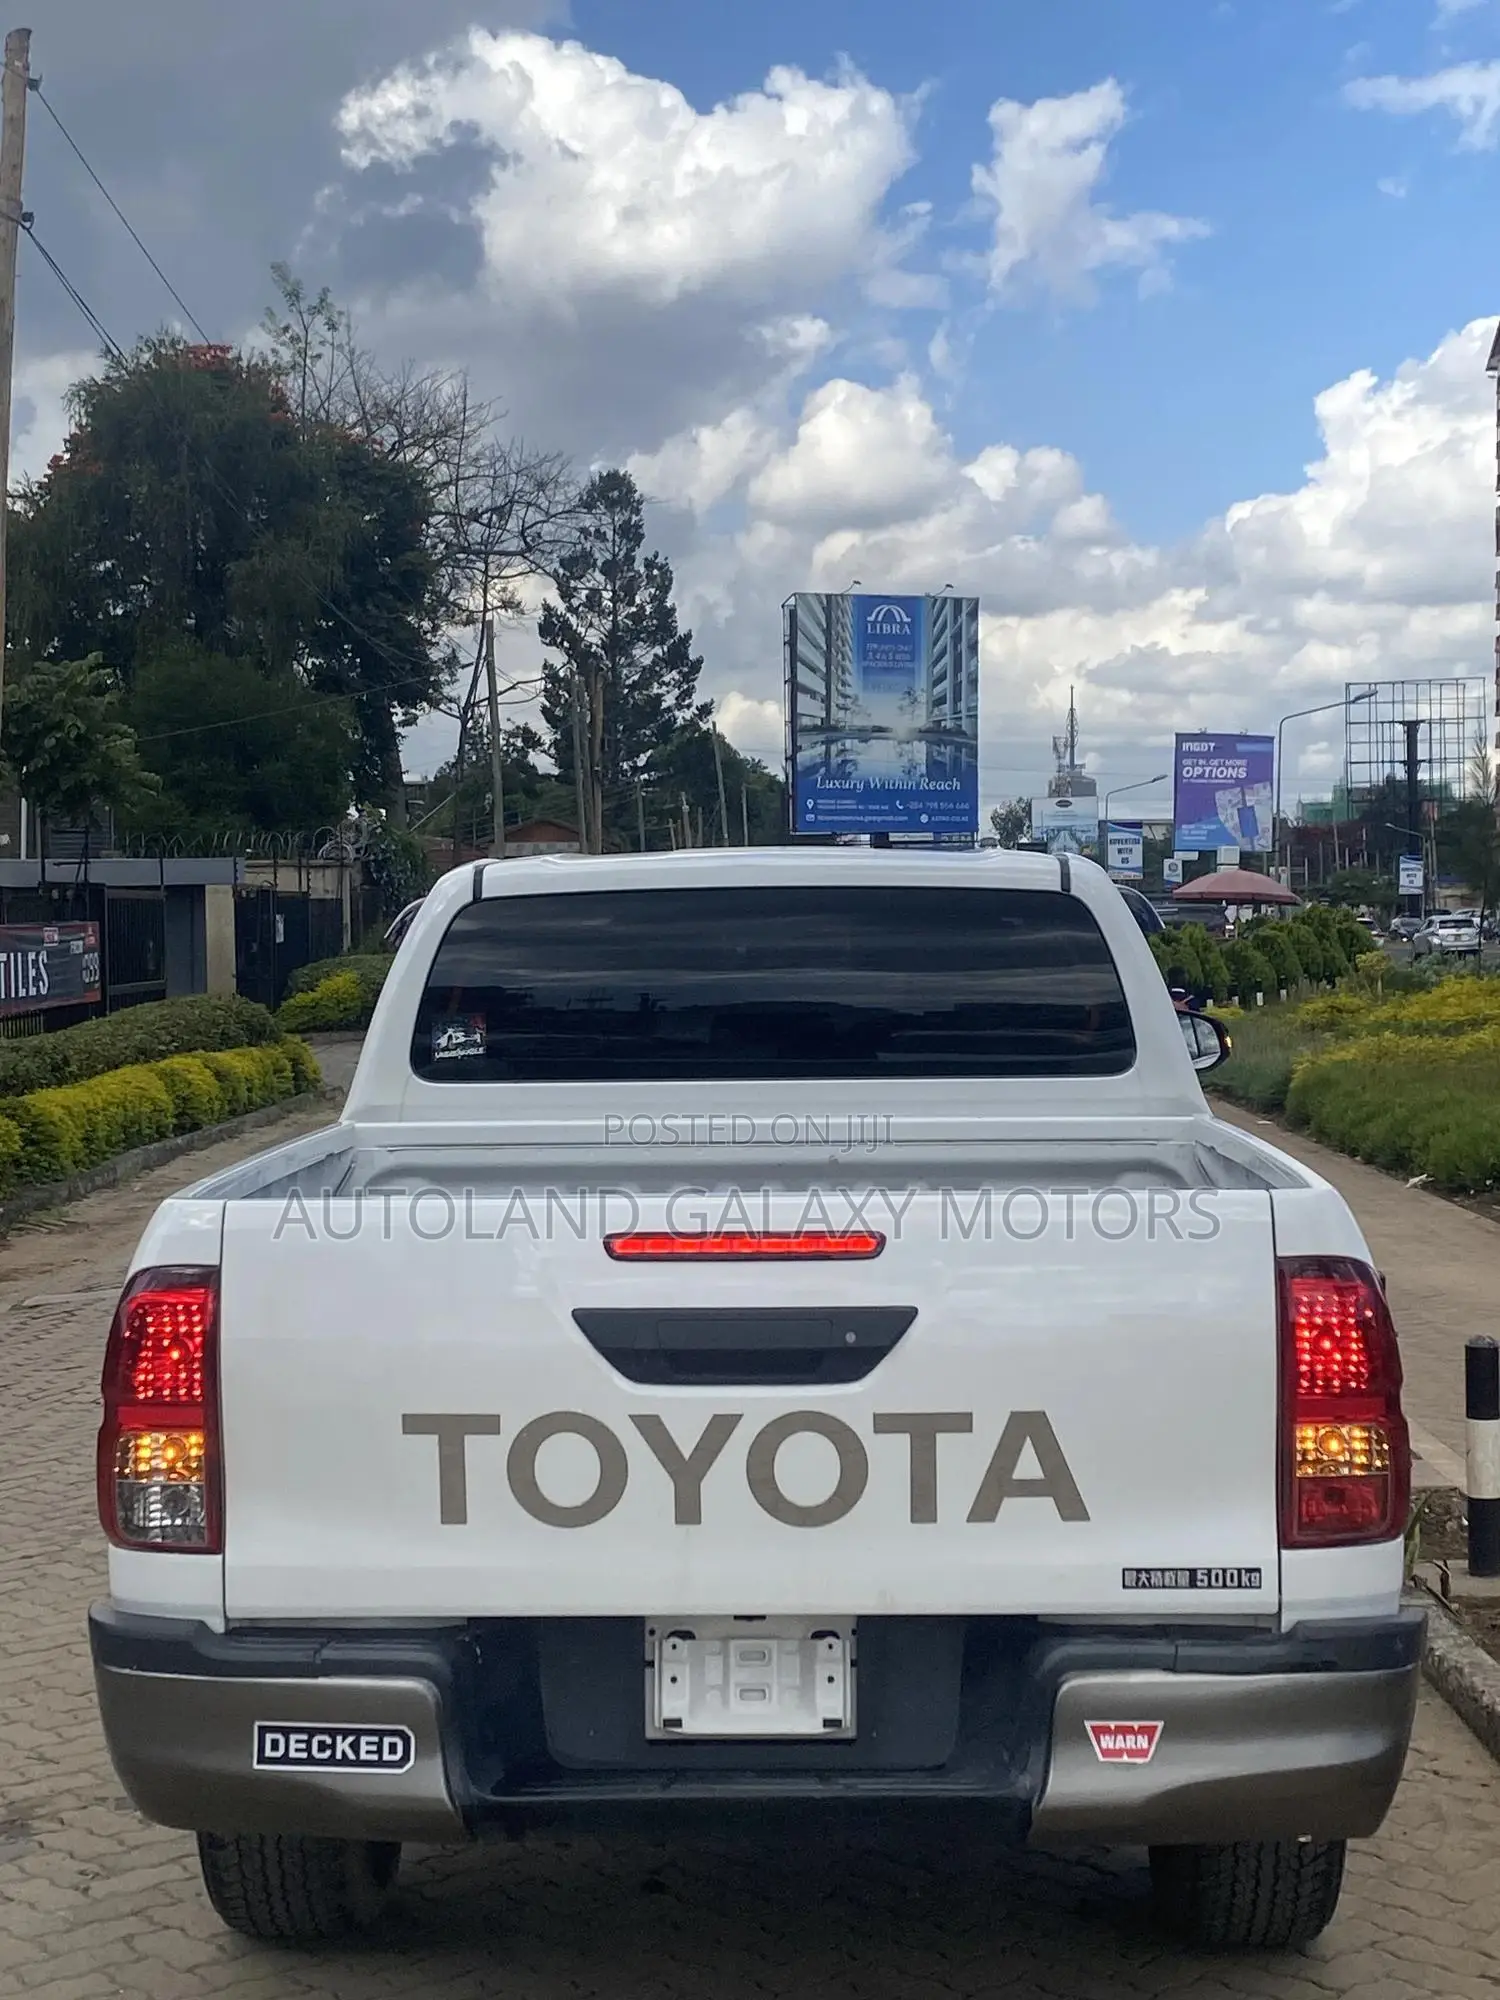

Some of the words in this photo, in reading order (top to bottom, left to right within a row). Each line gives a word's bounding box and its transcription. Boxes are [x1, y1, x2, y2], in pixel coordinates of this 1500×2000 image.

[867, 622, 911, 635] LIBRA
[1182, 766, 1248, 779] OPTIONS
[816, 776, 864, 793] Luxury
[869, 776, 917, 790] Within
[919, 777, 961, 791] Reach
[0, 950, 48, 999] TILES
[401, 1410, 1091, 1529] TOYOTA
[1195, 1569, 1260, 1588] 500kg
[264, 1732, 404, 1762] DECKED
[1099, 1734, 1149, 1749] WARN
